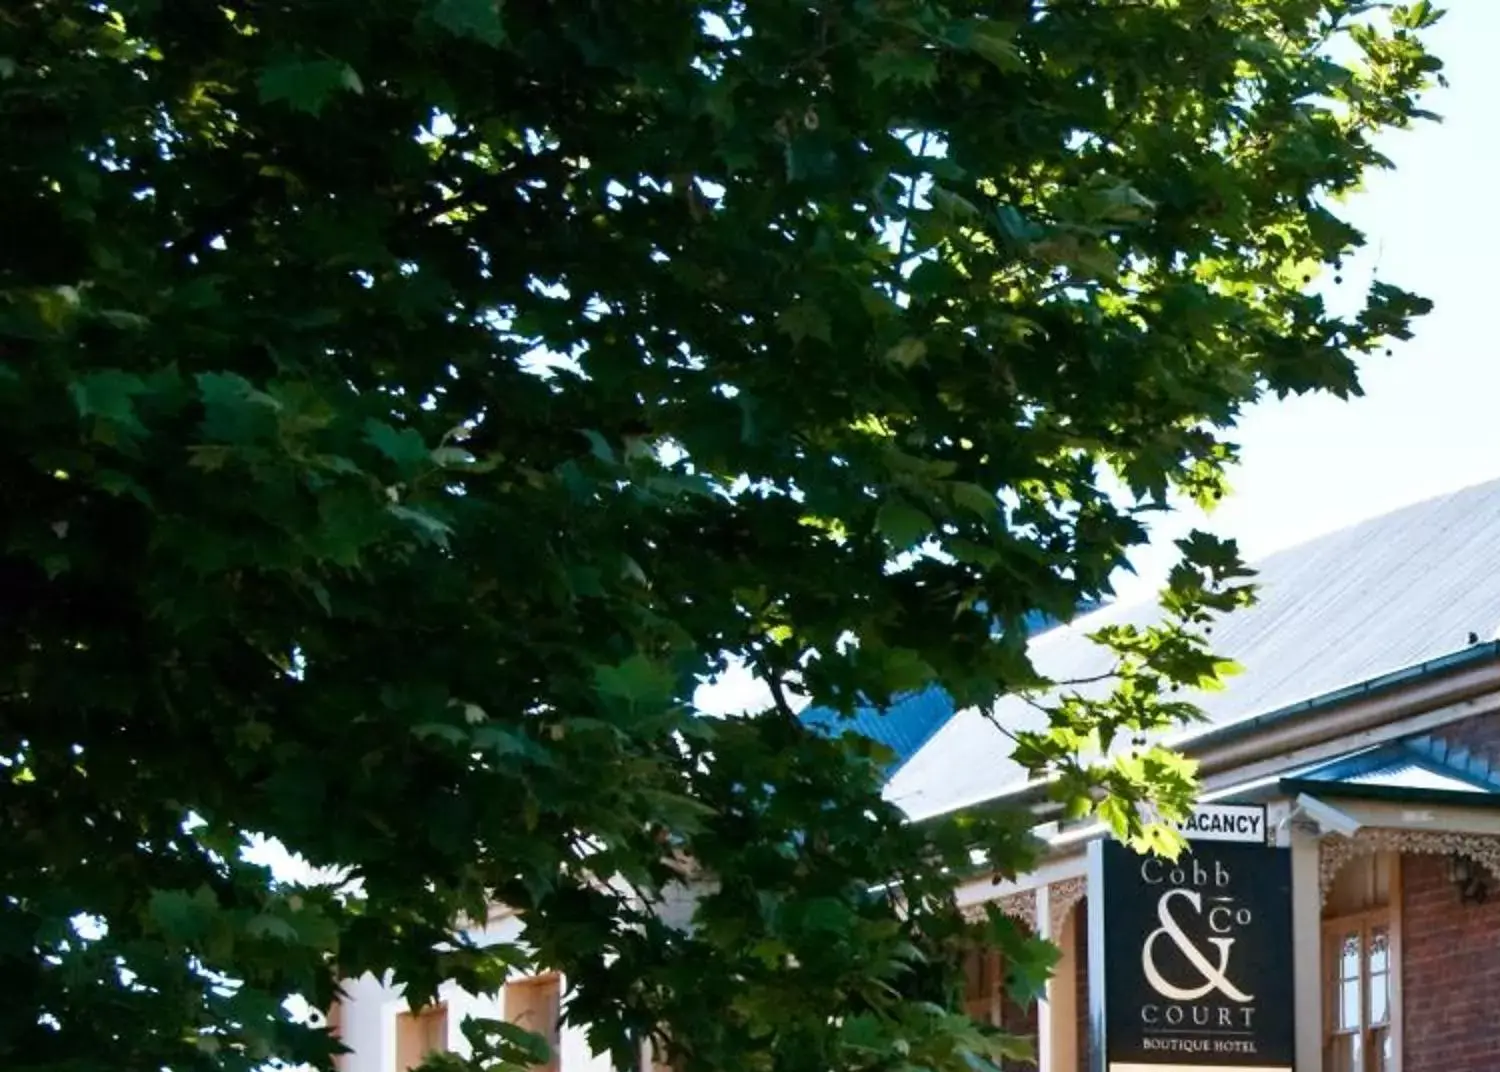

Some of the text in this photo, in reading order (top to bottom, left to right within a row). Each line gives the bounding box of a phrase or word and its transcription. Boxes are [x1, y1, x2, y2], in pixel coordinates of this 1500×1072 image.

[1141, 858, 1230, 887] Cobb
[1209, 905, 1251, 934] Co
[1142, 887, 1255, 1002] &
[1141, 1004, 1256, 1027] COURT
[1143, 1036, 1257, 1053] BOUTIQUE HOTEL
